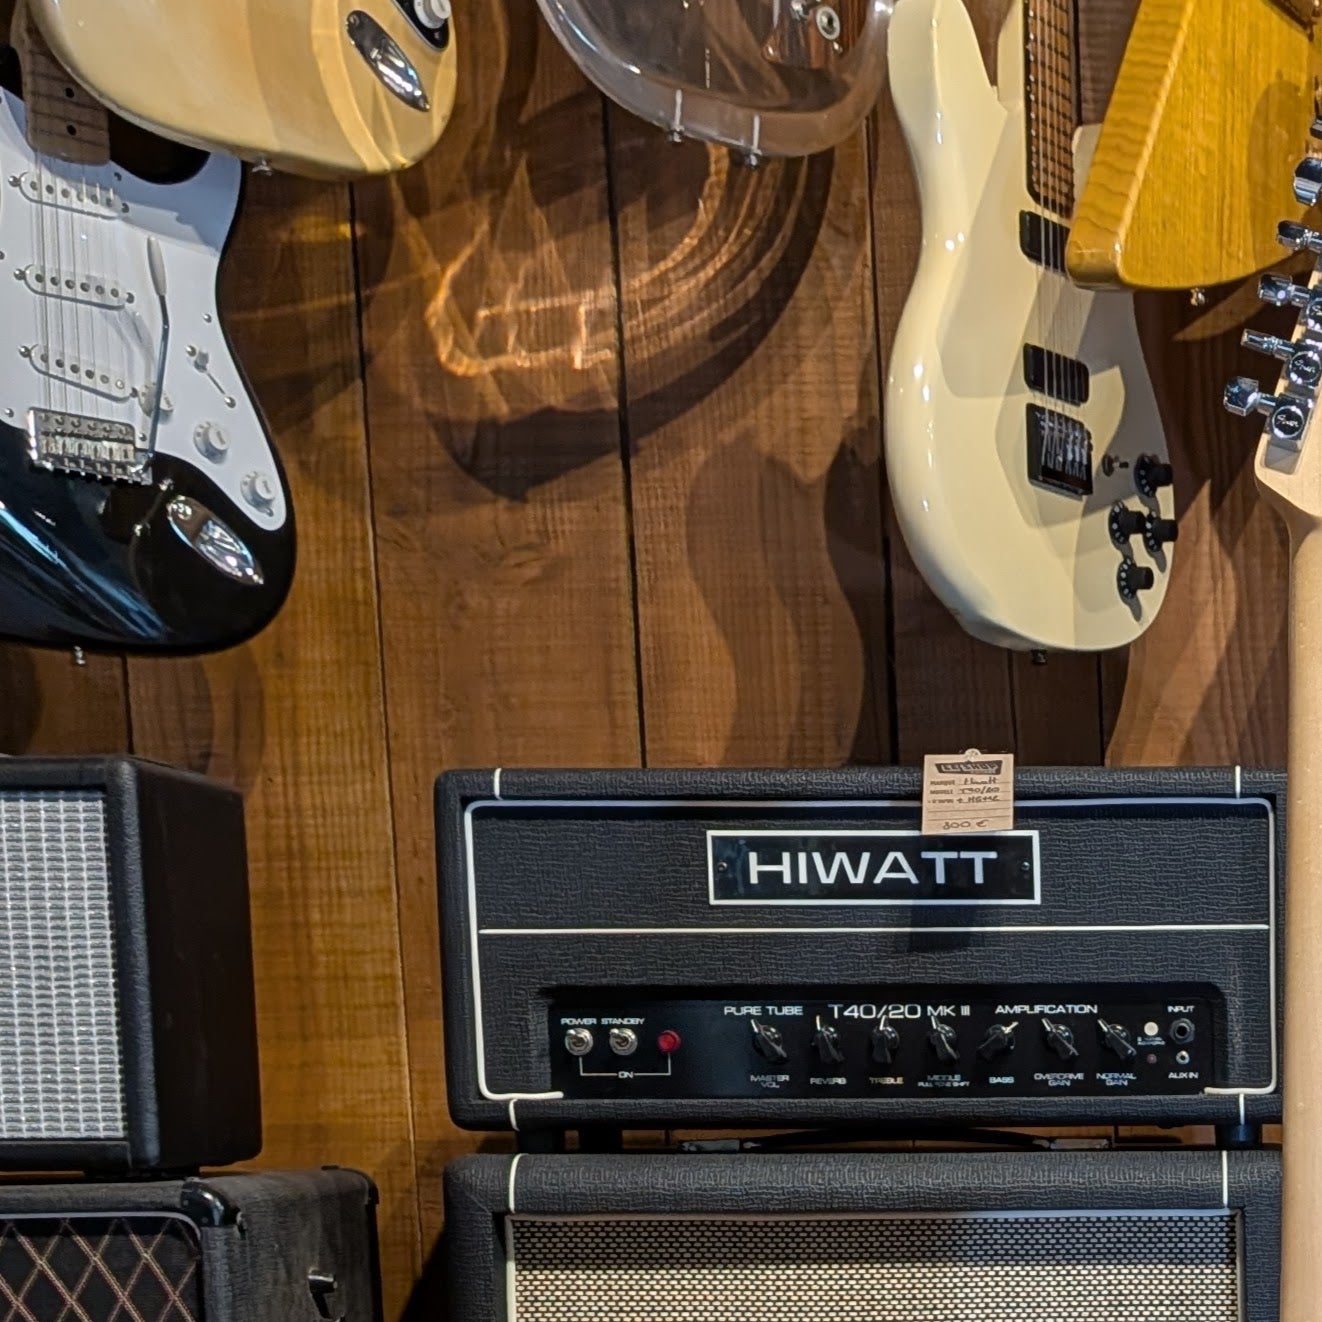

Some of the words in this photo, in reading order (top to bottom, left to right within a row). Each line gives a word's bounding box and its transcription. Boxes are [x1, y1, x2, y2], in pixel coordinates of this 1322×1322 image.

[748, 851, 998, 885] HIWATT
[724, 1005, 762, 1016] PURE
[768, 1005, 804, 1016] TUBE
[827, 1003, 921, 1019] T40/20
[927, 1004, 956, 1017] MK
[995, 1004, 1098, 1015] AMPLIFICATION
[1167, 1005, 1195, 1013] INPUT
[560, 1017, 598, 1025] POWER
[601, 1017, 645, 1025] STANDBY
[617, 1070, 634, 1079] ON
[750, 1074, 790, 1082] MASTER
[1033, 1072, 1085, 1080] OVERDRIVE
[1096, 1072, 1137, 1080] NORMAL
[1167, 1071, 1188, 1079] AUX
[1188, 1071, 1199, 1079] IN
[809, 1077, 848, 1085] REVERB
[868, 1076, 904, 1085] TREBLE
[988, 1076, 1015, 1084] BASS
